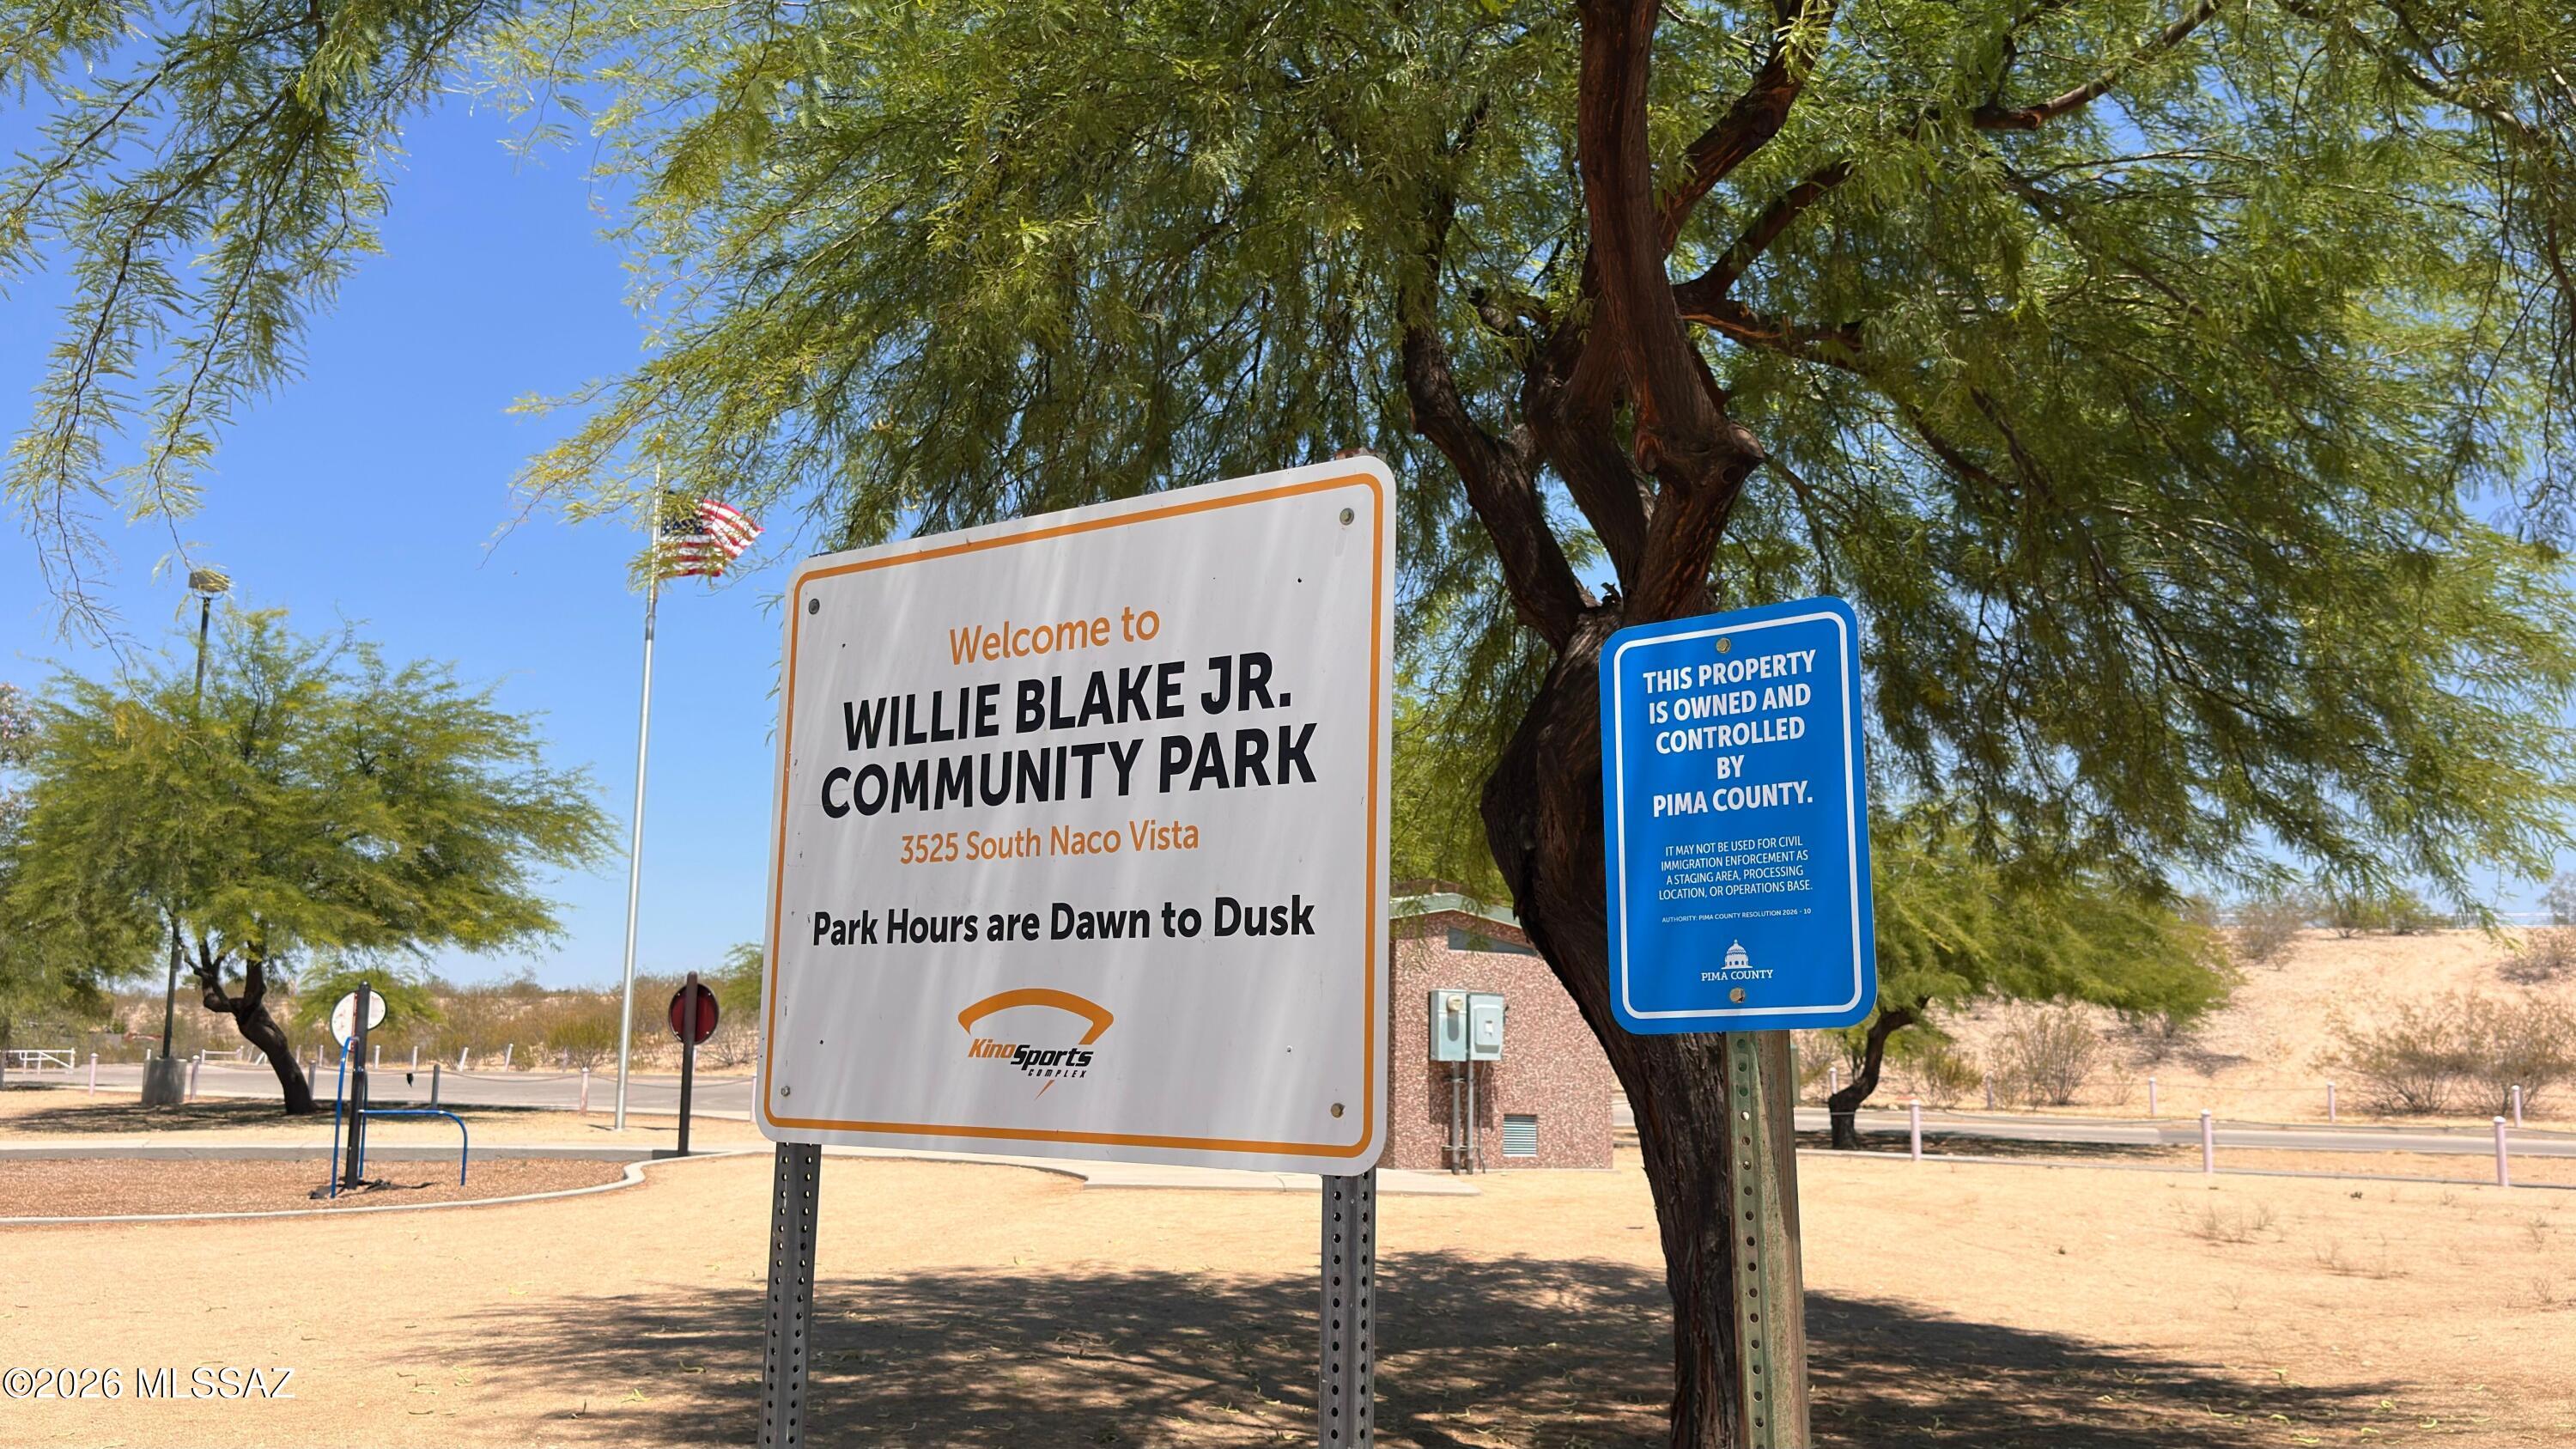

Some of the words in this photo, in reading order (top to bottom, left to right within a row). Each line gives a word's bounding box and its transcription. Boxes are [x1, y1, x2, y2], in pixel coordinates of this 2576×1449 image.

[950, 617, 1110, 665] Welcome
[1121, 606, 1159, 642] to
[1643, 667, 1692, 694] THIS
[1698, 649, 1816, 687] PROPERTY
[843, 683, 1000, 751] WILLIE
[1015, 661, 1185, 734] BLAKE
[1200, 651, 1291, 715] JR.
[1649, 701, 1668, 724] IS
[1674, 690, 1757, 721] OWNED
[1762, 683, 1811, 710] AND
[1656, 716, 1805, 754] CONTROLLED
[821, 739, 1144, 819] COMMUNITY
[1159, 723, 1317, 794] PARK
[1717, 755, 1745, 779] BY
[1654, 791, 1708, 817] PIMA
[1712, 780, 1813, 812] COUNTY.
[900, 832, 959, 864] 3525
[965, 828, 1041, 860] South
[1049, 825, 1121, 855] Naco
[1128, 819, 1200, 852] Vista
[1662, 857, 1722, 871] IMMIGRATION
[1726, 851, 1795, 866] ENFORCEMENT
[1796, 849, 1808, 860] AS
[1666, 846, 1674, 856] IT
[1676, 844, 1694, 855] MAY
[1696, 843, 1716, 854] NOT
[1718, 842, 1729, 852] BE
[1731, 840, 1755, 851] USED
[1758, 837, 1777, 849] FOR
[1778, 836, 1802, 847] CIVIL
[1659, 887, 1707, 900] LOCATION,
[1710, 886, 1723, 897] OR
[1726, 881, 1784, 895] OPERATIONS
[1787, 880, 1813, 891] BASE.
[1667, 875, 1673, 885] A
[1674, 872, 1713, 884] STAGING
[1716, 870, 1741, 881] AREA,
[1744, 865, 1803, 880] PROCESSING
[812, 910, 878, 946] Park
[886, 907, 978, 944] Hours
[987, 913, 1041, 941] are
[1050, 902, 1150, 940] Dawn
[1161, 902, 1202, 938] to
[1214, 895, 1315, 937] Dusk
[1701, 971, 1728, 982] PIMA
[1731, 970, 1773, 980] COUNTY
[1028, 1069, 1086, 1078] COMPLEX
